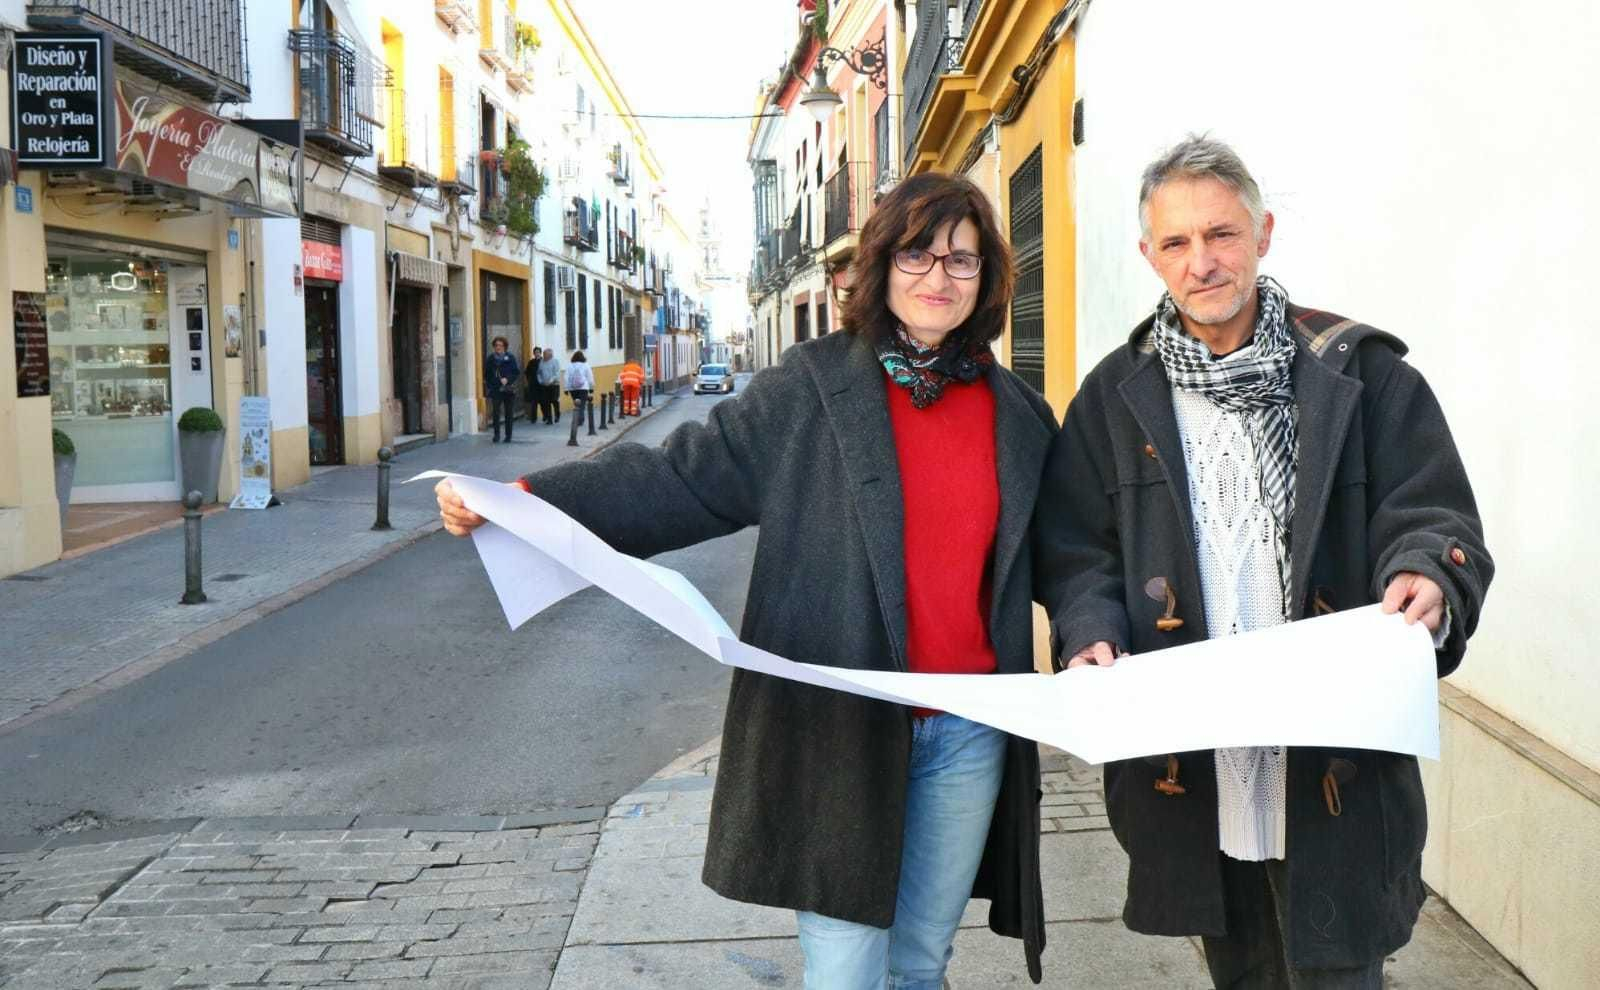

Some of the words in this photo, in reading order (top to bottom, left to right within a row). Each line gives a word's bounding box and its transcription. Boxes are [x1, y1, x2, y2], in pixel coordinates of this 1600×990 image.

[26, 45, 76, 66] Diseño
[78, 49, 87, 69] y
[18, 70, 97, 96] Reparación
[49, 98, 66, 109] en
[22, 112, 47, 125] Oro
[50, 114, 59, 128] y
[61, 111, 94, 125] Plata
[116, 96, 192, 168] Joyería
[195, 120, 257, 168] Platería
[28, 136, 90, 156] Relojería
